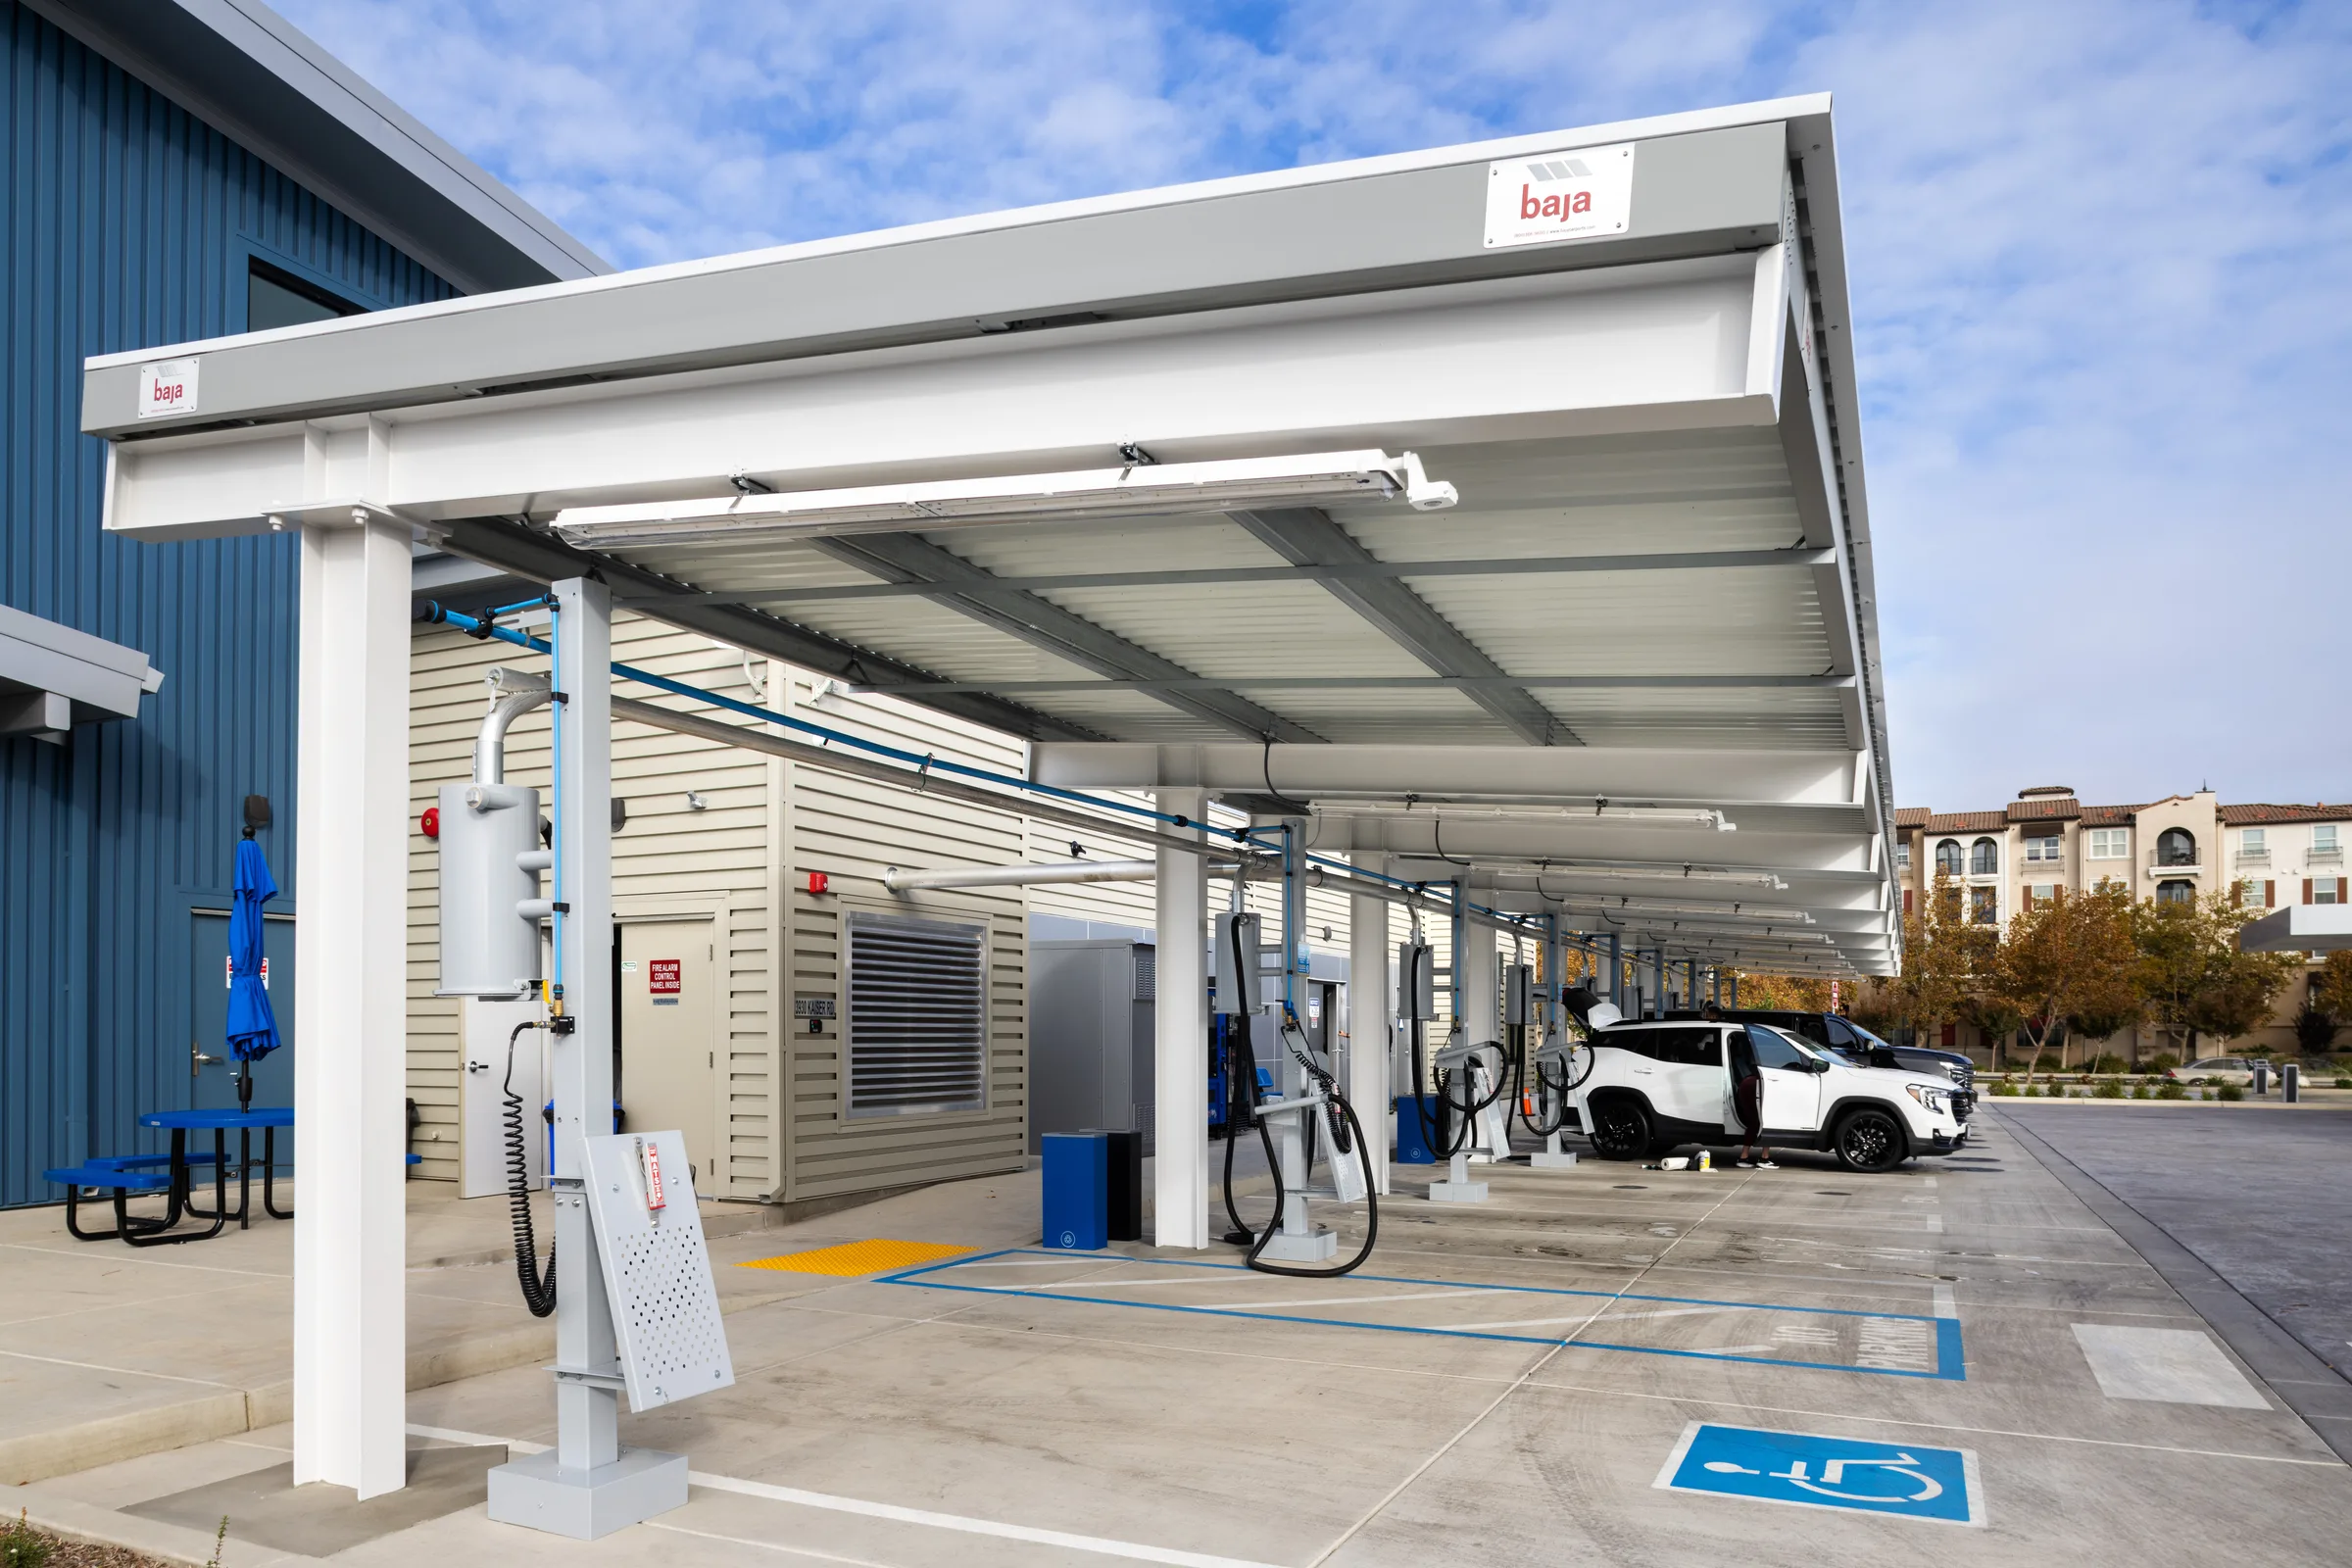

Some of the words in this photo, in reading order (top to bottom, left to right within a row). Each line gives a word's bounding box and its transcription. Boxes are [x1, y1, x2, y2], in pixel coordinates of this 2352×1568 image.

[1521, 183, 1592, 222] baja
[154, 378, 183, 404] baja
[796, 1000, 807, 1015] 3930
[807, 1000, 826, 1015] KAISER
[651, 1156, 661, 1185] MATS
[1770, 1325, 1839, 1346] NO
[1855, 1316, 1930, 1372] PARKING
